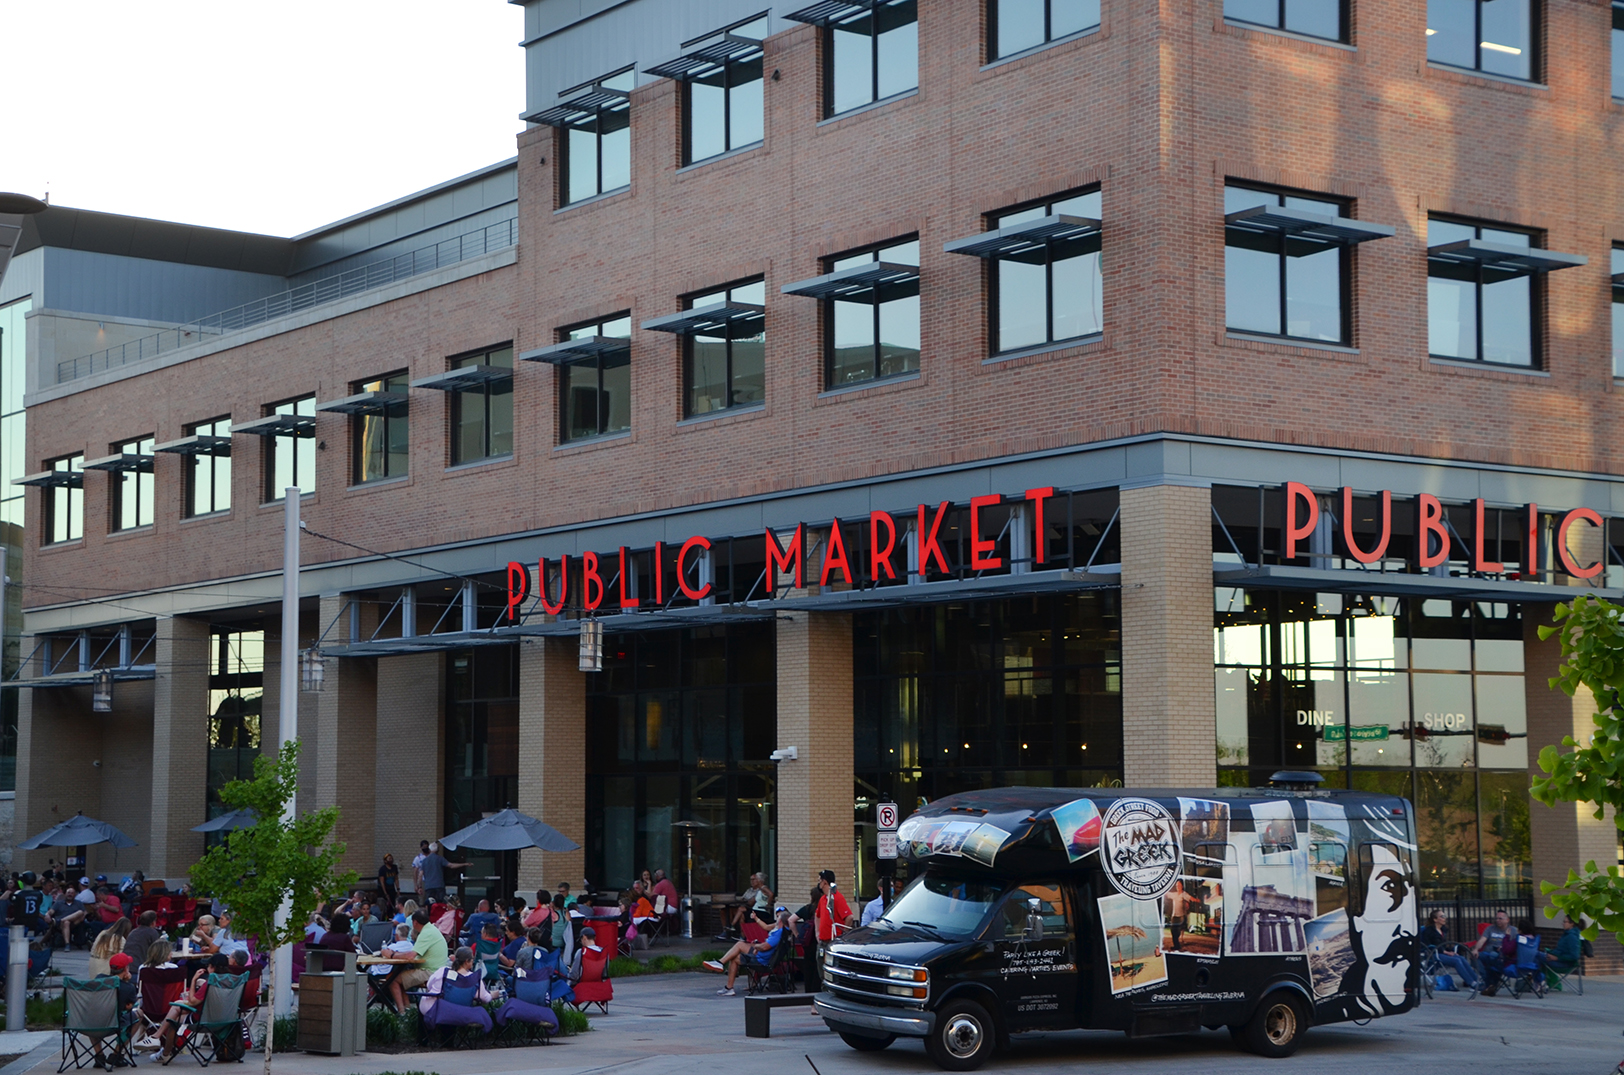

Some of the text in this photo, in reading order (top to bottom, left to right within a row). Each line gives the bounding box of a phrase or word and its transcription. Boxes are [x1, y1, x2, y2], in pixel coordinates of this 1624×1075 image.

[1283, 481, 1605, 579] PUBLIC
[508, 487, 1057, 620] PUBLIC MARKET
[1297, 710, 1334, 726] DINE
[1424, 712, 1466, 728] SHOP
[1112, 821, 1166, 848] The MAD
[1113, 840, 1173, 869] GREEK
[25, 900, 37, 914] 13
